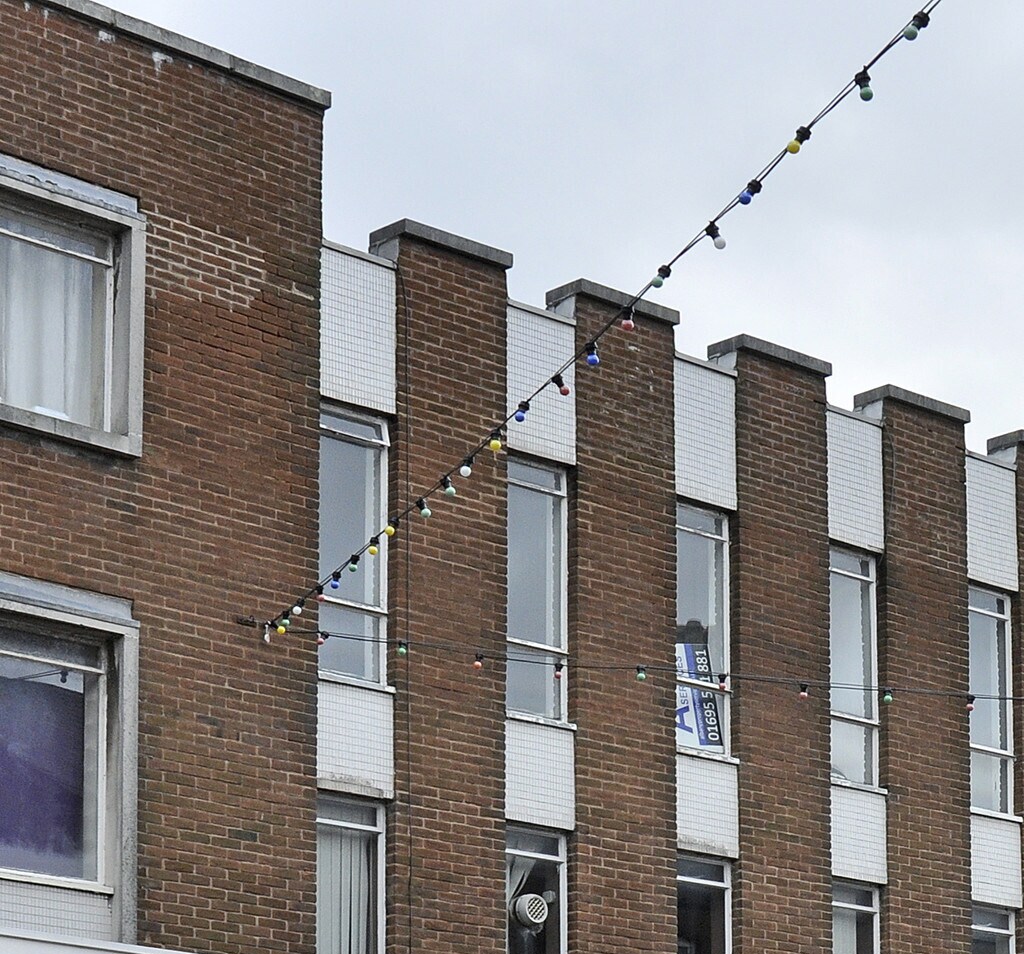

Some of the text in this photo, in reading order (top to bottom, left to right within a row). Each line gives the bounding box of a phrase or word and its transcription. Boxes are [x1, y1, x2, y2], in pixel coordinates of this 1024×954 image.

[695, 650, 709, 672] 881
[700, 676, 714, 699] 51
[703, 702, 720, 740] 01695
